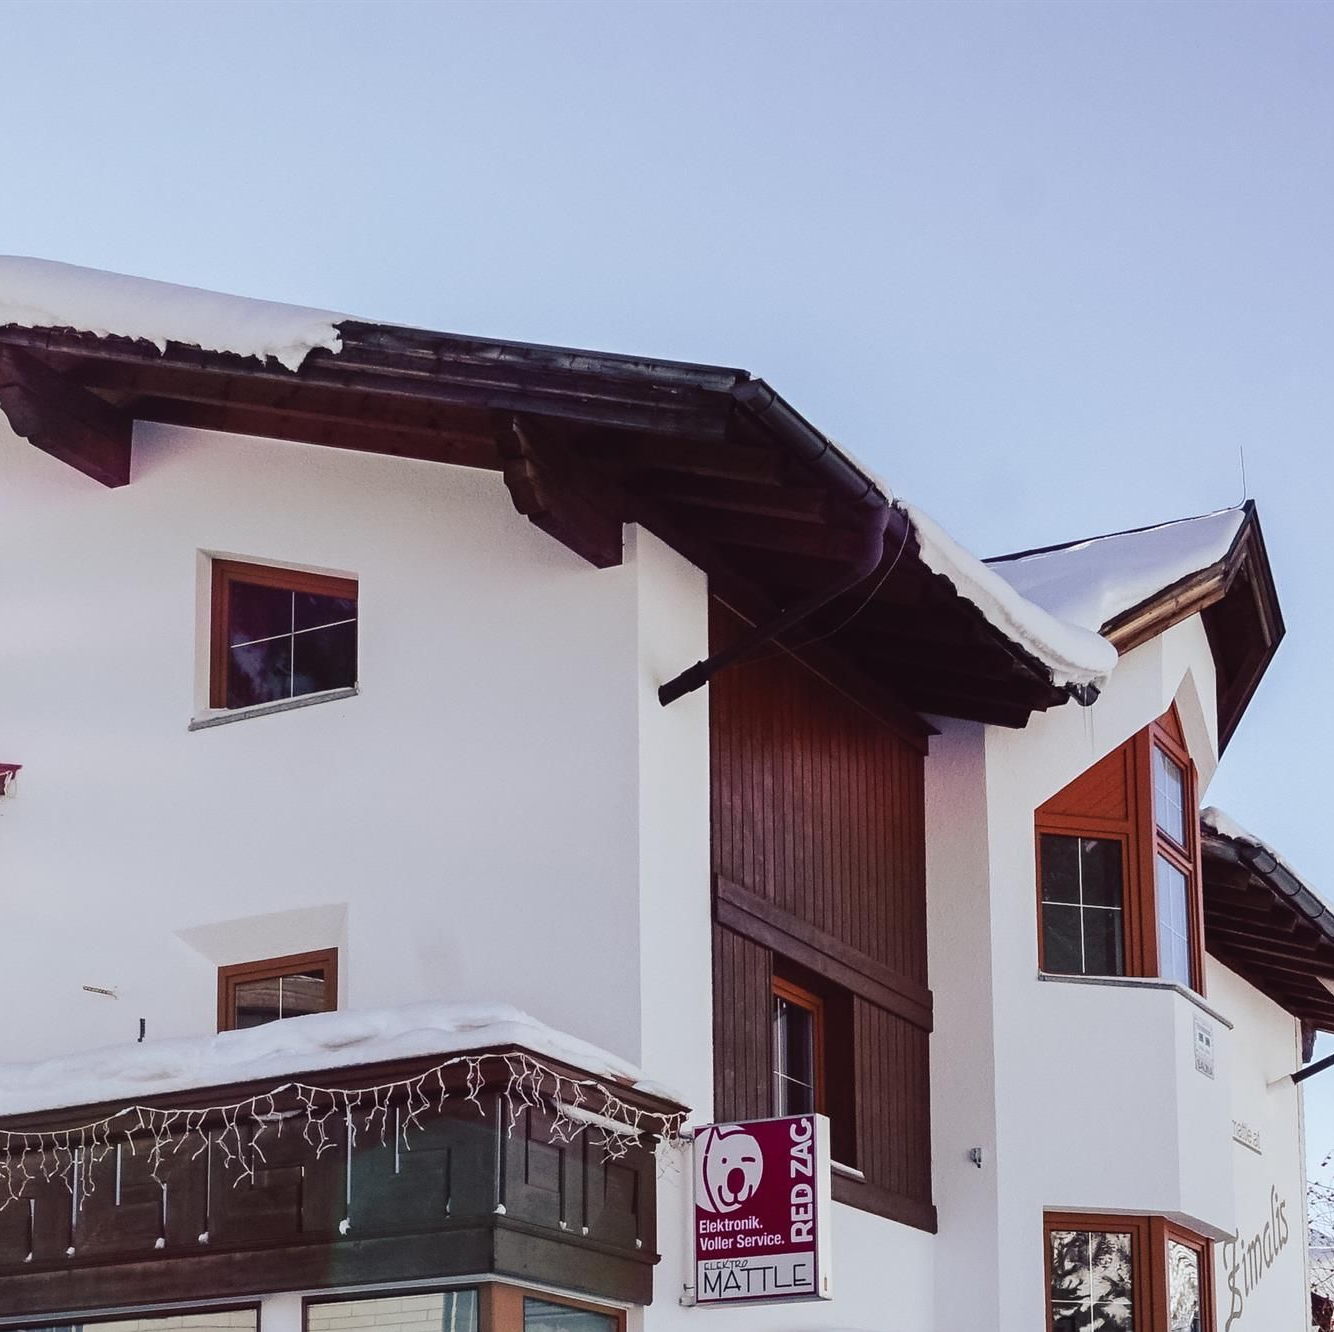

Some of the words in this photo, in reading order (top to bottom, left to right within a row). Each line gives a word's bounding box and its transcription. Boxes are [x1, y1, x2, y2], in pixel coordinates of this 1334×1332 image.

[790, 1117, 814, 1178] ZAC
[699, 1215, 763, 1234] Elektronik.
[791, 1184, 814, 1243] RED
[700, 1236, 734, 1251] Voller
[736, 1232, 785, 1248] Service.
[704, 1260, 748, 1271] ELEKTRO
[703, 1263, 812, 1298] MATTLE
